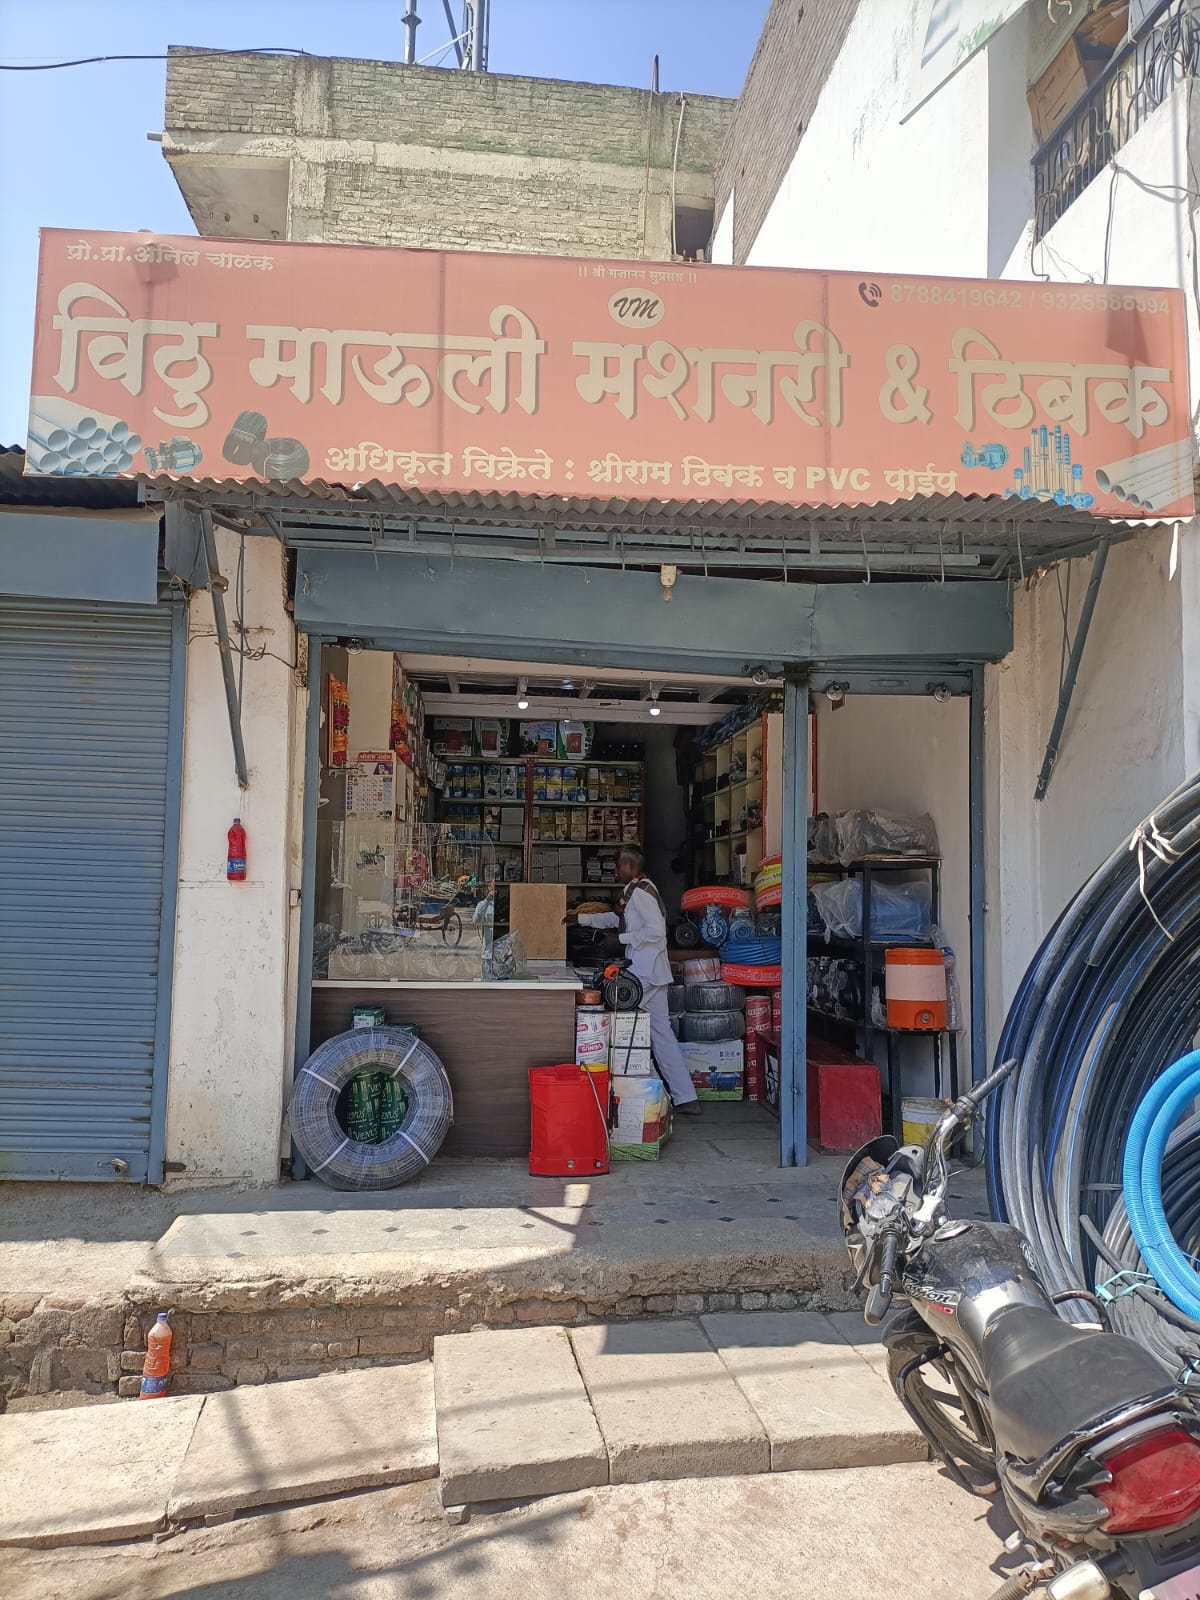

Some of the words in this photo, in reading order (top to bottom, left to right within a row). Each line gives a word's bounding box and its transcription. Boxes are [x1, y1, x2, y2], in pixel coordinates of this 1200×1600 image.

[207, 252, 274, 270] चाळक
[592, 264, 605, 278] श्री
[608, 268, 645, 280] गजानन
[890, 284, 1022, 309] 8788419642
[52, 282, 219, 429] विठु
[246, 304, 547, 416] माऊली
[572, 319, 850, 428] मशनरी
[879, 343, 934, 424] &
[948, 326, 1172, 440] ठिबक
[324, 441, 453, 485] अधिकृत
[462, 446, 554, 481] विक्रेते
[586, 452, 673, 485] श्रीराम
[681, 455, 764, 488] ठिबक
[772, 465, 797, 489] व
[806, 466, 871, 490] PVC
[884, 462, 959, 493] पाईप
[353, 1128, 378, 1141] VENUS
